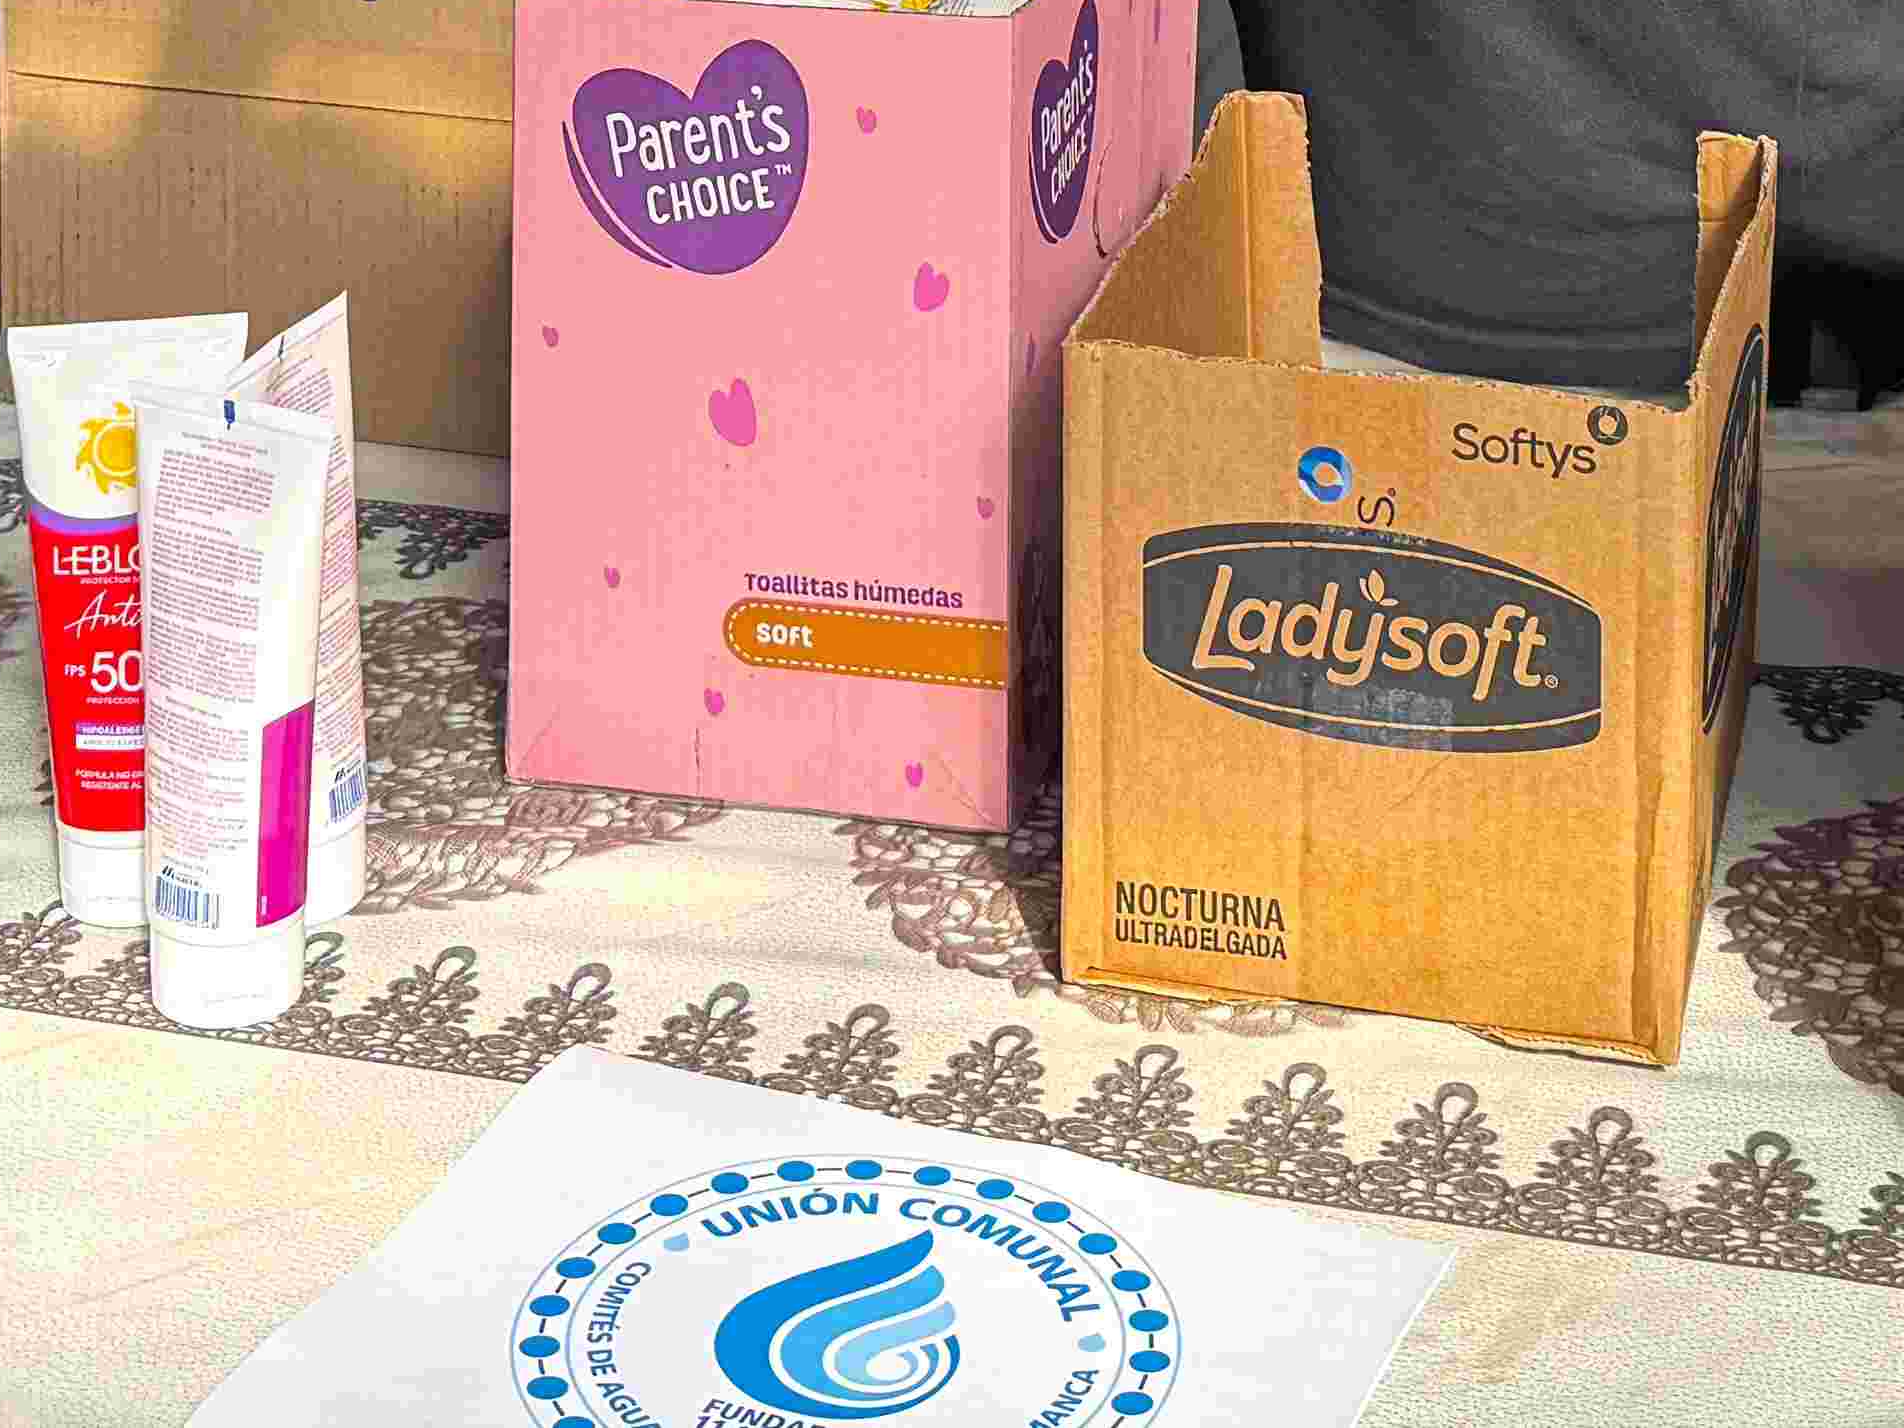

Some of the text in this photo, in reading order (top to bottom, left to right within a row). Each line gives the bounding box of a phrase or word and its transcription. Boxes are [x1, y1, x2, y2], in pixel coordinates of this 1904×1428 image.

[606, 86, 792, 178] Parent's
[1040, 40, 1095, 172] Parent's
[1050, 120, 1089, 206] CHOICE
[645, 166, 775, 225] CHOICE
[1452, 422, 1598, 479] Softys
[53, 544, 143, 576] LEBL
[745, 572, 964, 609] Toallitas húmedas
[755, 621, 813, 649] soft
[1191, 564, 1552, 701] Ladysoft
[64, 664, 86, 676] FPS
[1115, 880, 1287, 933] NOCTURNA
[1115, 917, 1288, 961] ULTRADELGADA
[699, 1187, 1100, 1324] UNIÓN COMUNAL
[586, 1260, 652, 1346] COMITÉS
[587, 1347, 618, 1378] DE
